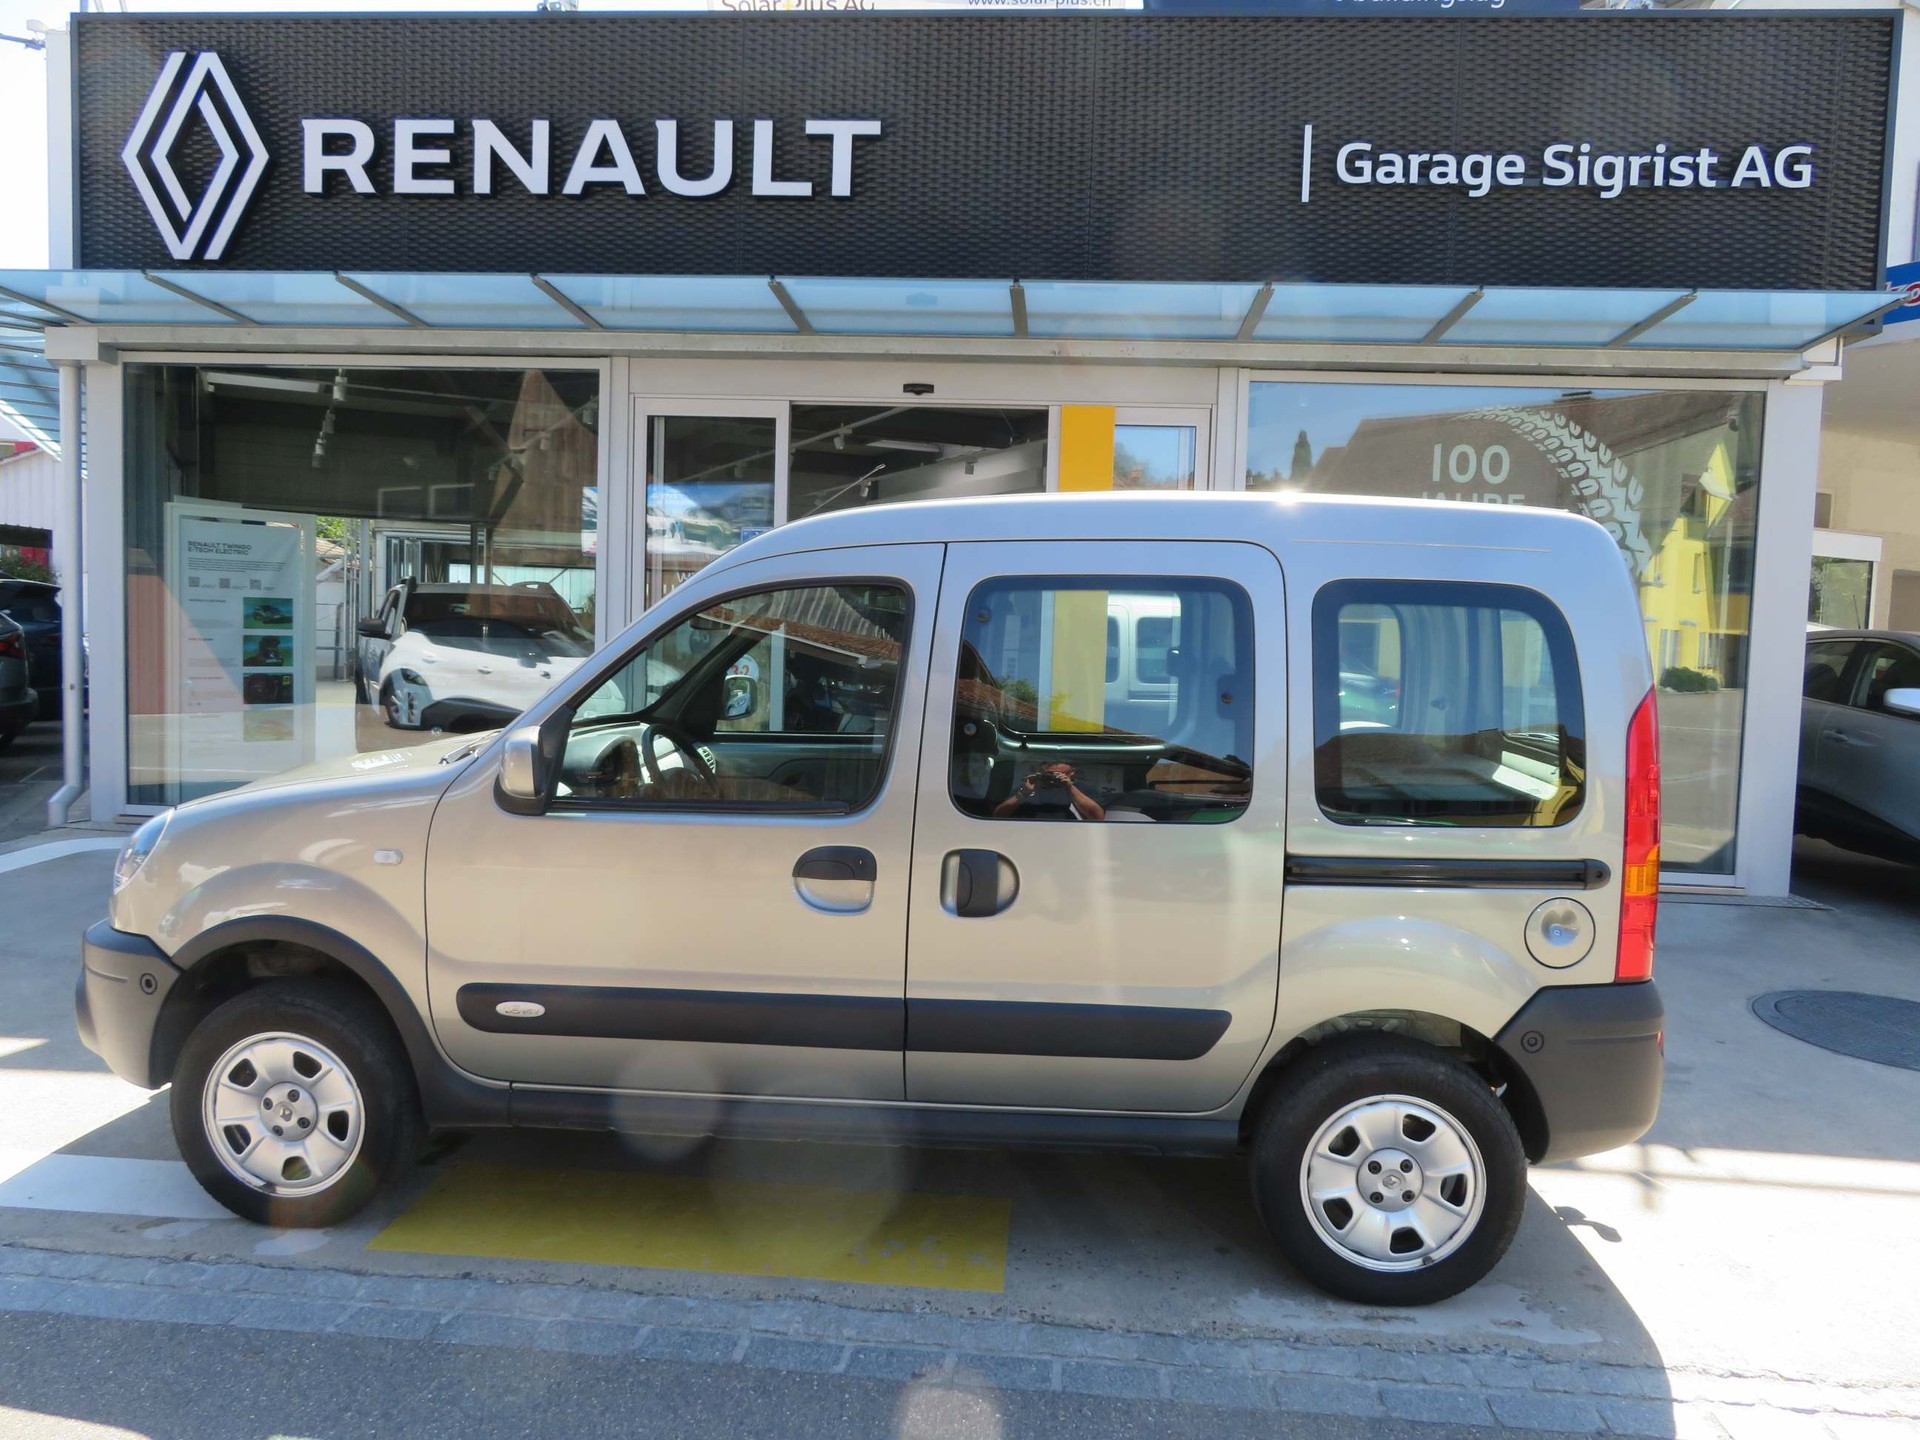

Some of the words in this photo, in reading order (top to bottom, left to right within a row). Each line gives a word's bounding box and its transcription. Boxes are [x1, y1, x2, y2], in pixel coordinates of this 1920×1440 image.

[302, 119, 882, 197] RENAULT
[1336, 142, 1526, 198] Garage
[1542, 143, 1718, 199] Sigrist
[1730, 145, 1813, 189] AG
[1432, 443, 1510, 484] 100
